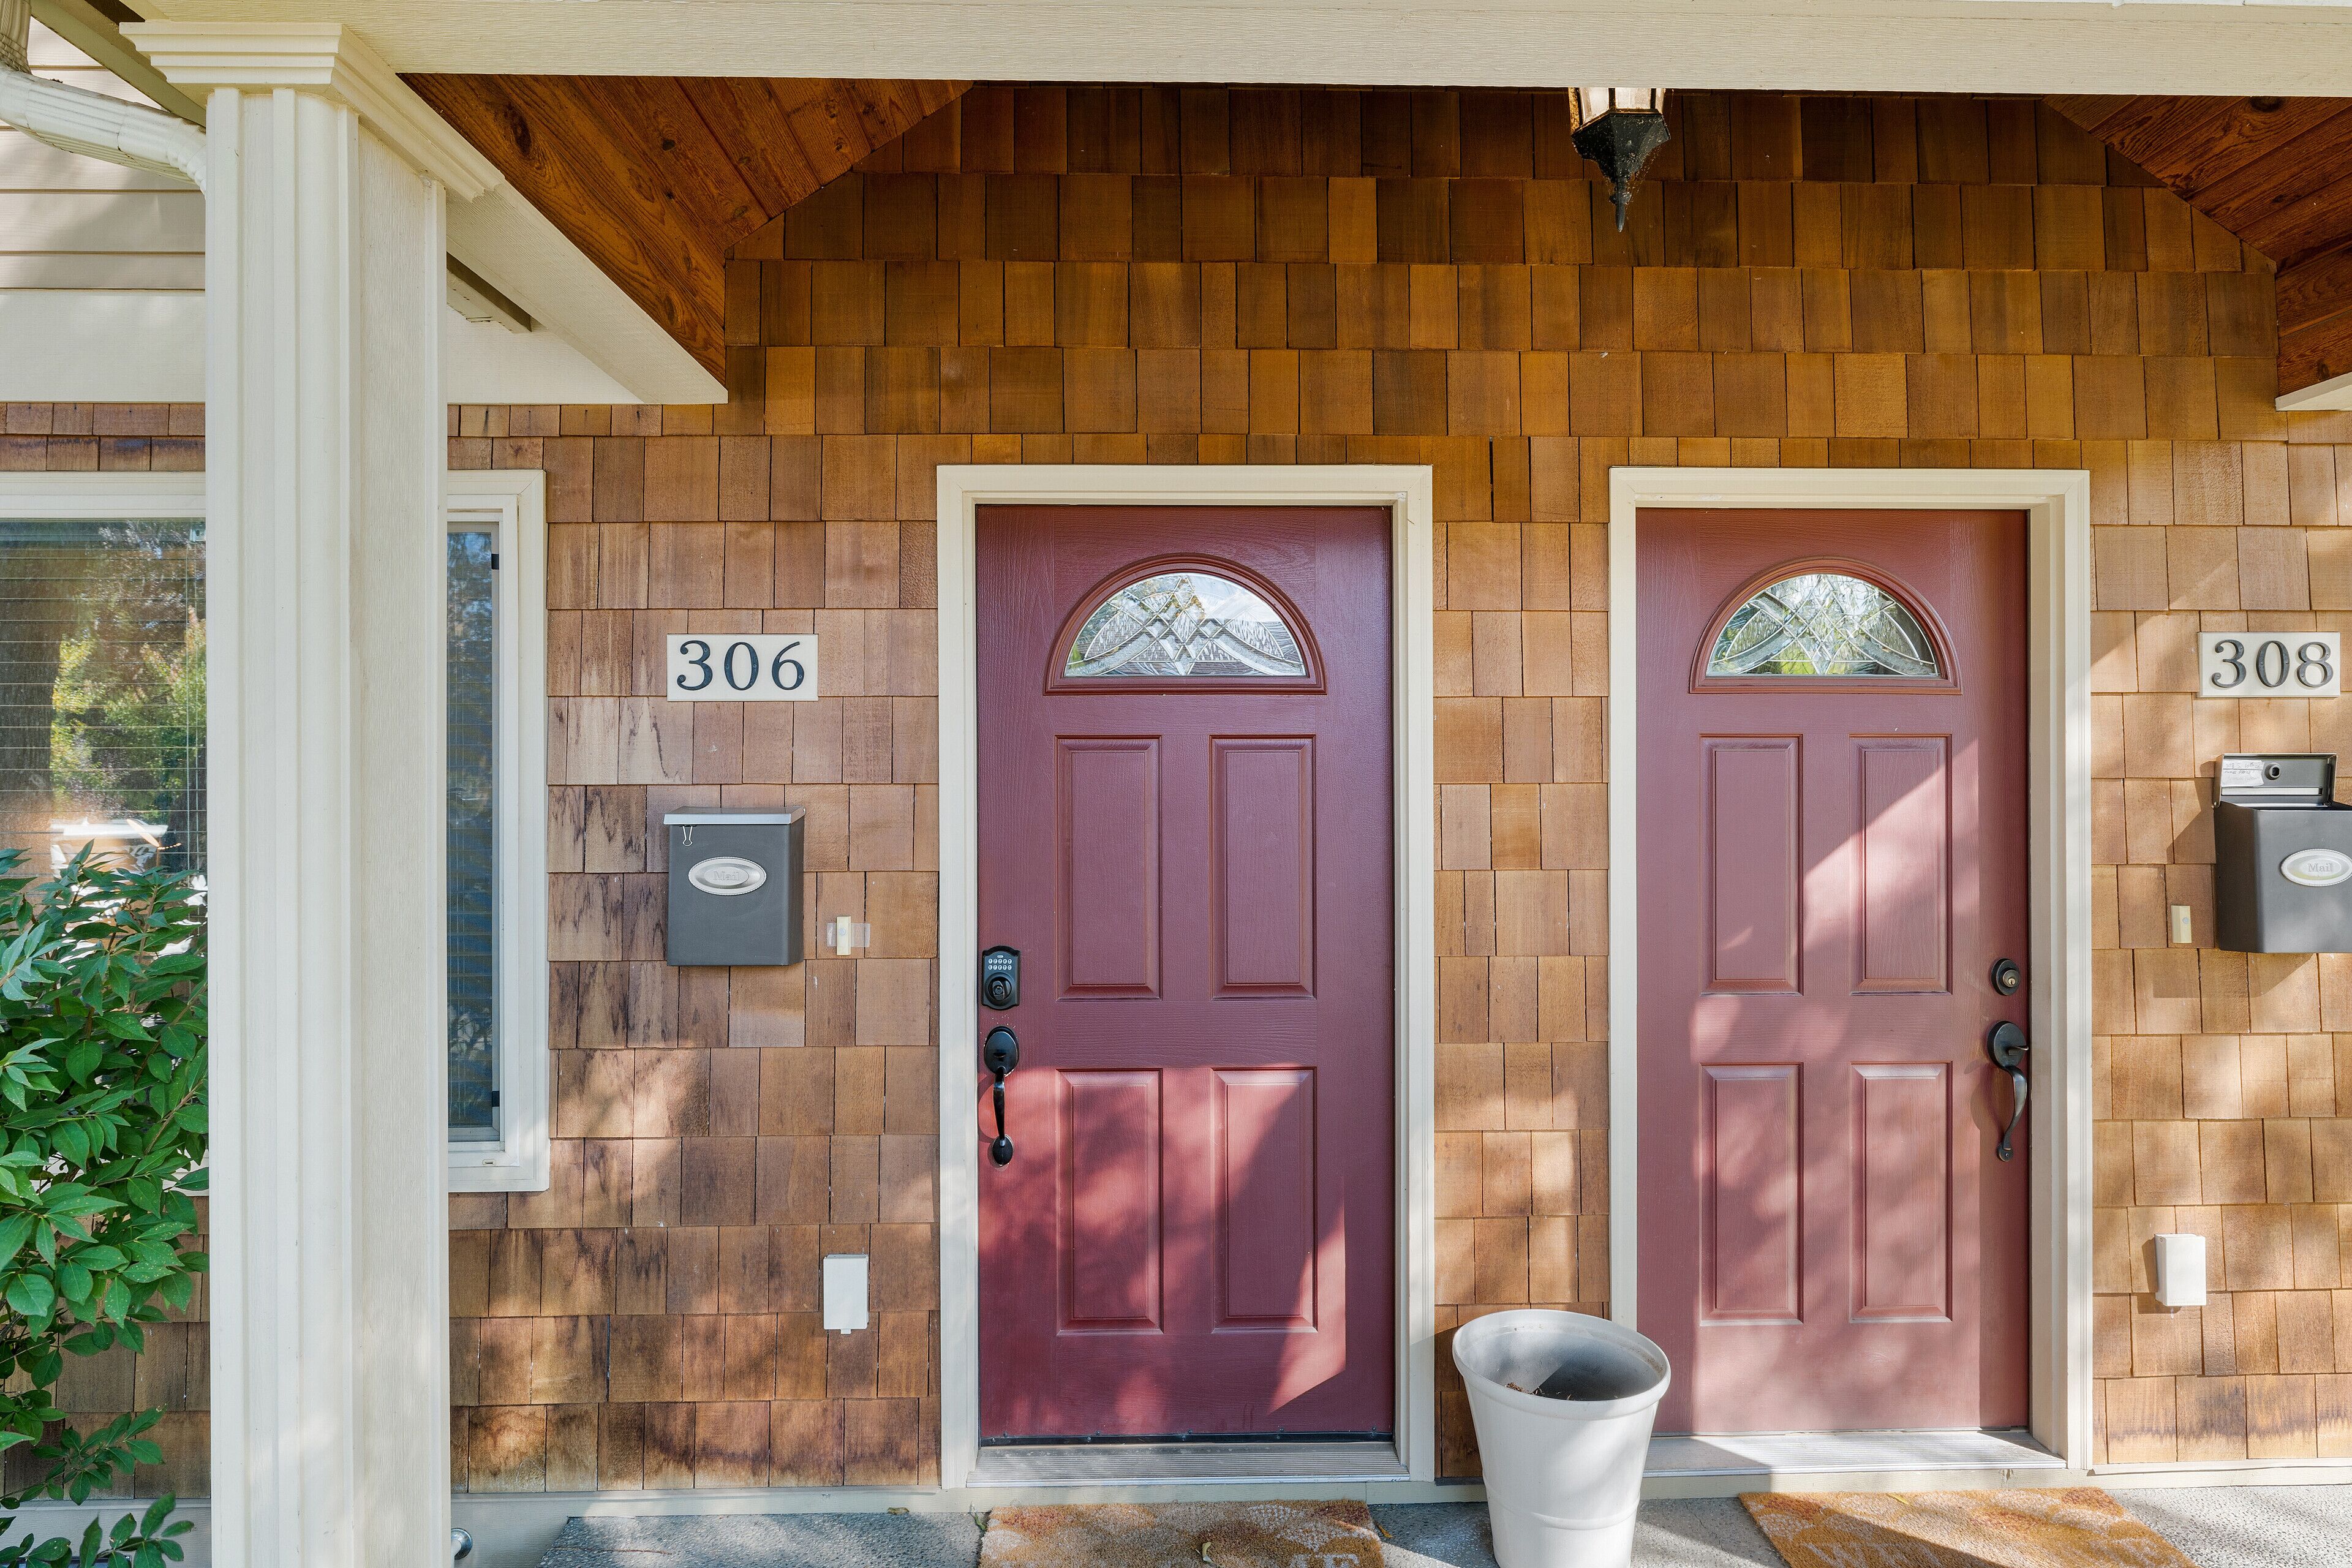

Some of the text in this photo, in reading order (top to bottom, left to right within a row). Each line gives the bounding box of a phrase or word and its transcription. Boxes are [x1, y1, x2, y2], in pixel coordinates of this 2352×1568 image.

[676, 639, 805, 691] 306
[2211, 639, 2334, 688] 308
[713, 870, 740, 881] Mail
[2307, 862, 2333, 872] Mail
